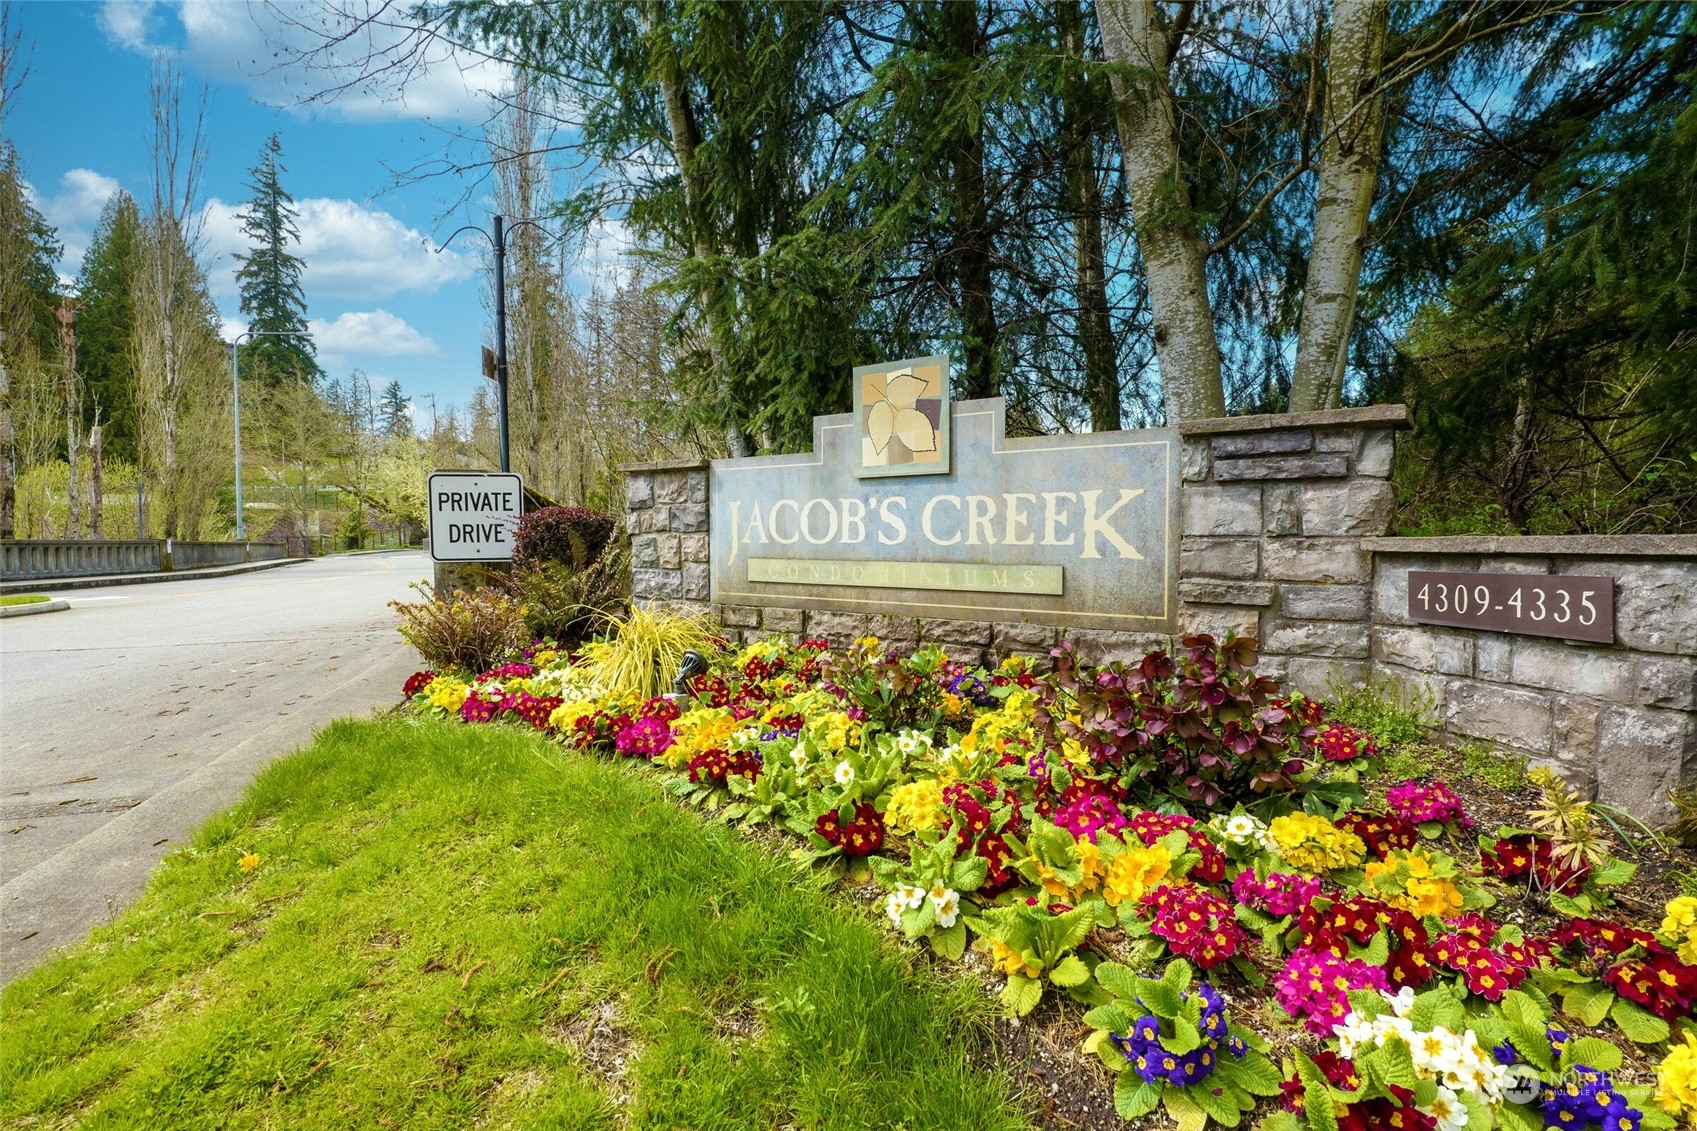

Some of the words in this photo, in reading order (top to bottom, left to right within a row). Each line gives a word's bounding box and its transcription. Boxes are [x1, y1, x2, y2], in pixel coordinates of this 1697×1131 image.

[438, 492, 513, 512] PRIVATE
[449, 524, 505, 543] DRIVE
[728, 497, 907, 566] JACOB'S
[921, 488, 1145, 560] CREEK
[767, 563, 1036, 589] CONDOMINIUMS
[1417, 583, 1597, 625] 4309-4335
